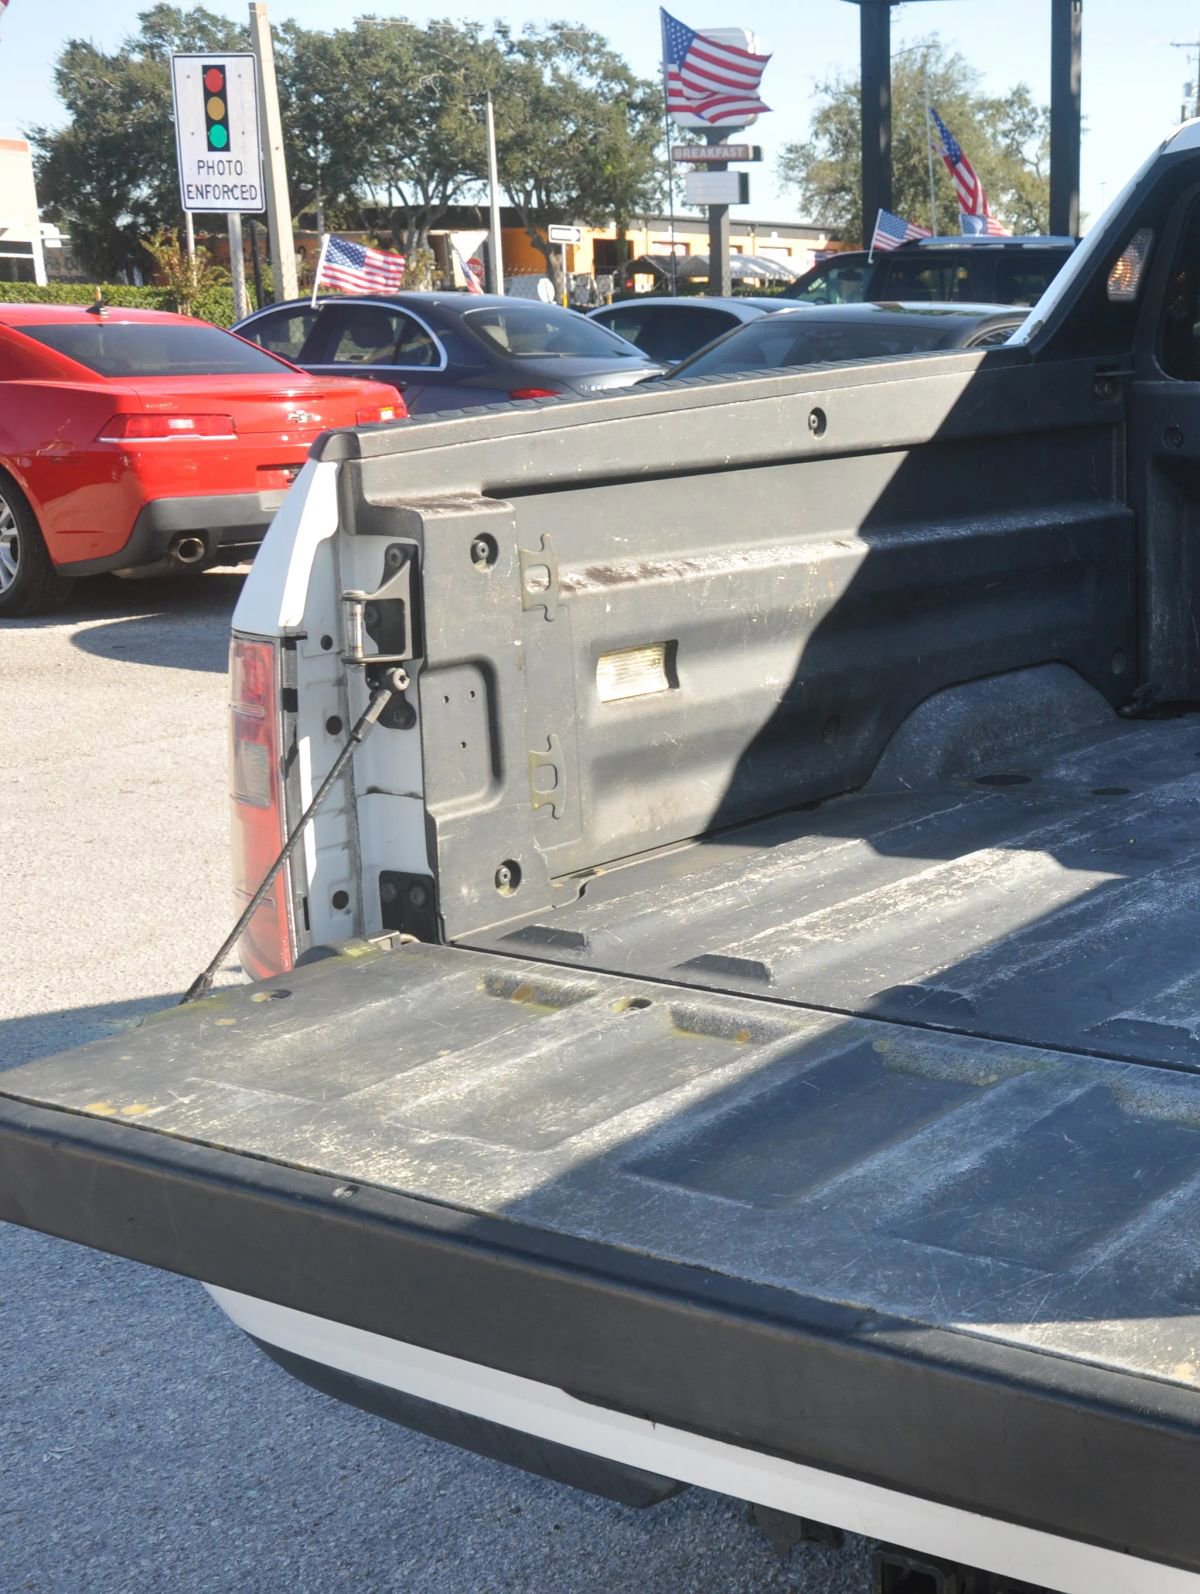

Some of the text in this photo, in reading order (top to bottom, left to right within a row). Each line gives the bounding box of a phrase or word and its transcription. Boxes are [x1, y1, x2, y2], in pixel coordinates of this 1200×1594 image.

[674, 147, 744, 159] BREAKFAST
[197, 160, 243, 176] PHOTO
[186, 184, 258, 201] ENFORCED
